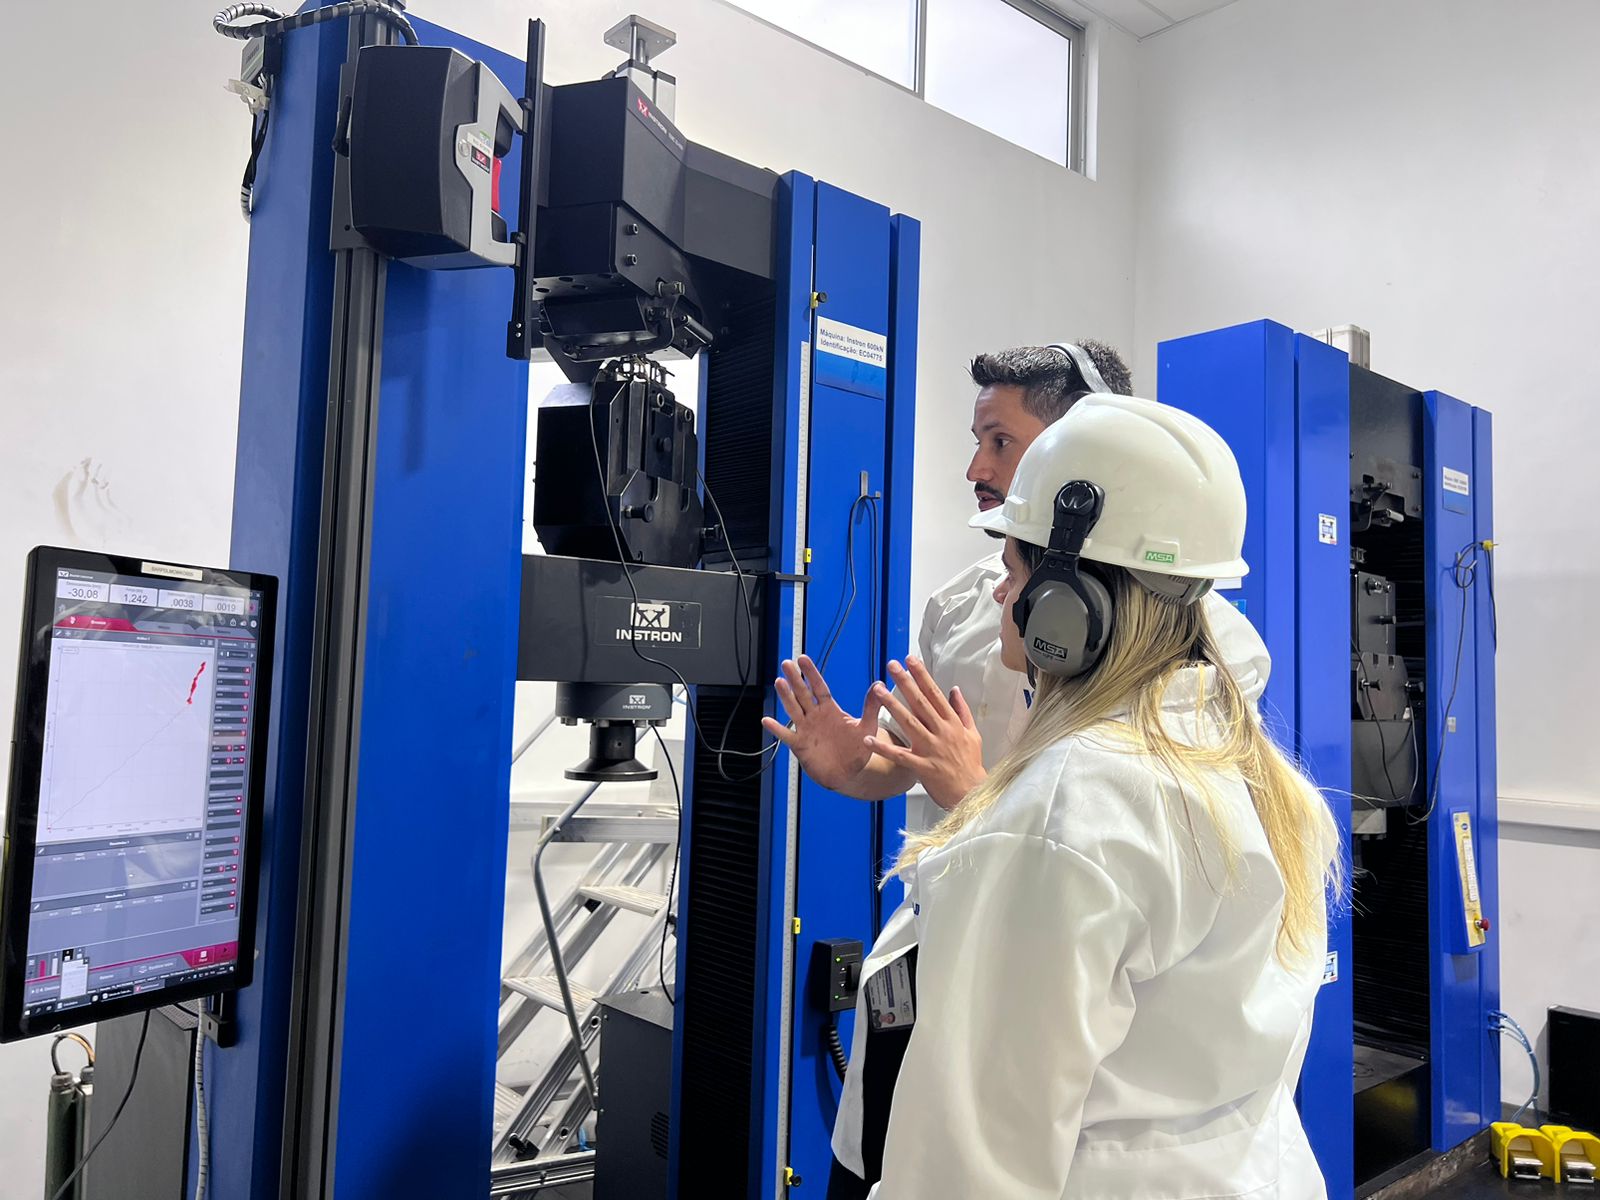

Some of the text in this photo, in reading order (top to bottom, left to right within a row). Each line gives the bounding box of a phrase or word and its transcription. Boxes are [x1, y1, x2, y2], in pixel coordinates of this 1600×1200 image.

[1146, 551, 1174, 562] MSA
[616, 629, 682, 642] INSTRON
[1035, 639, 1065, 658] MSA
